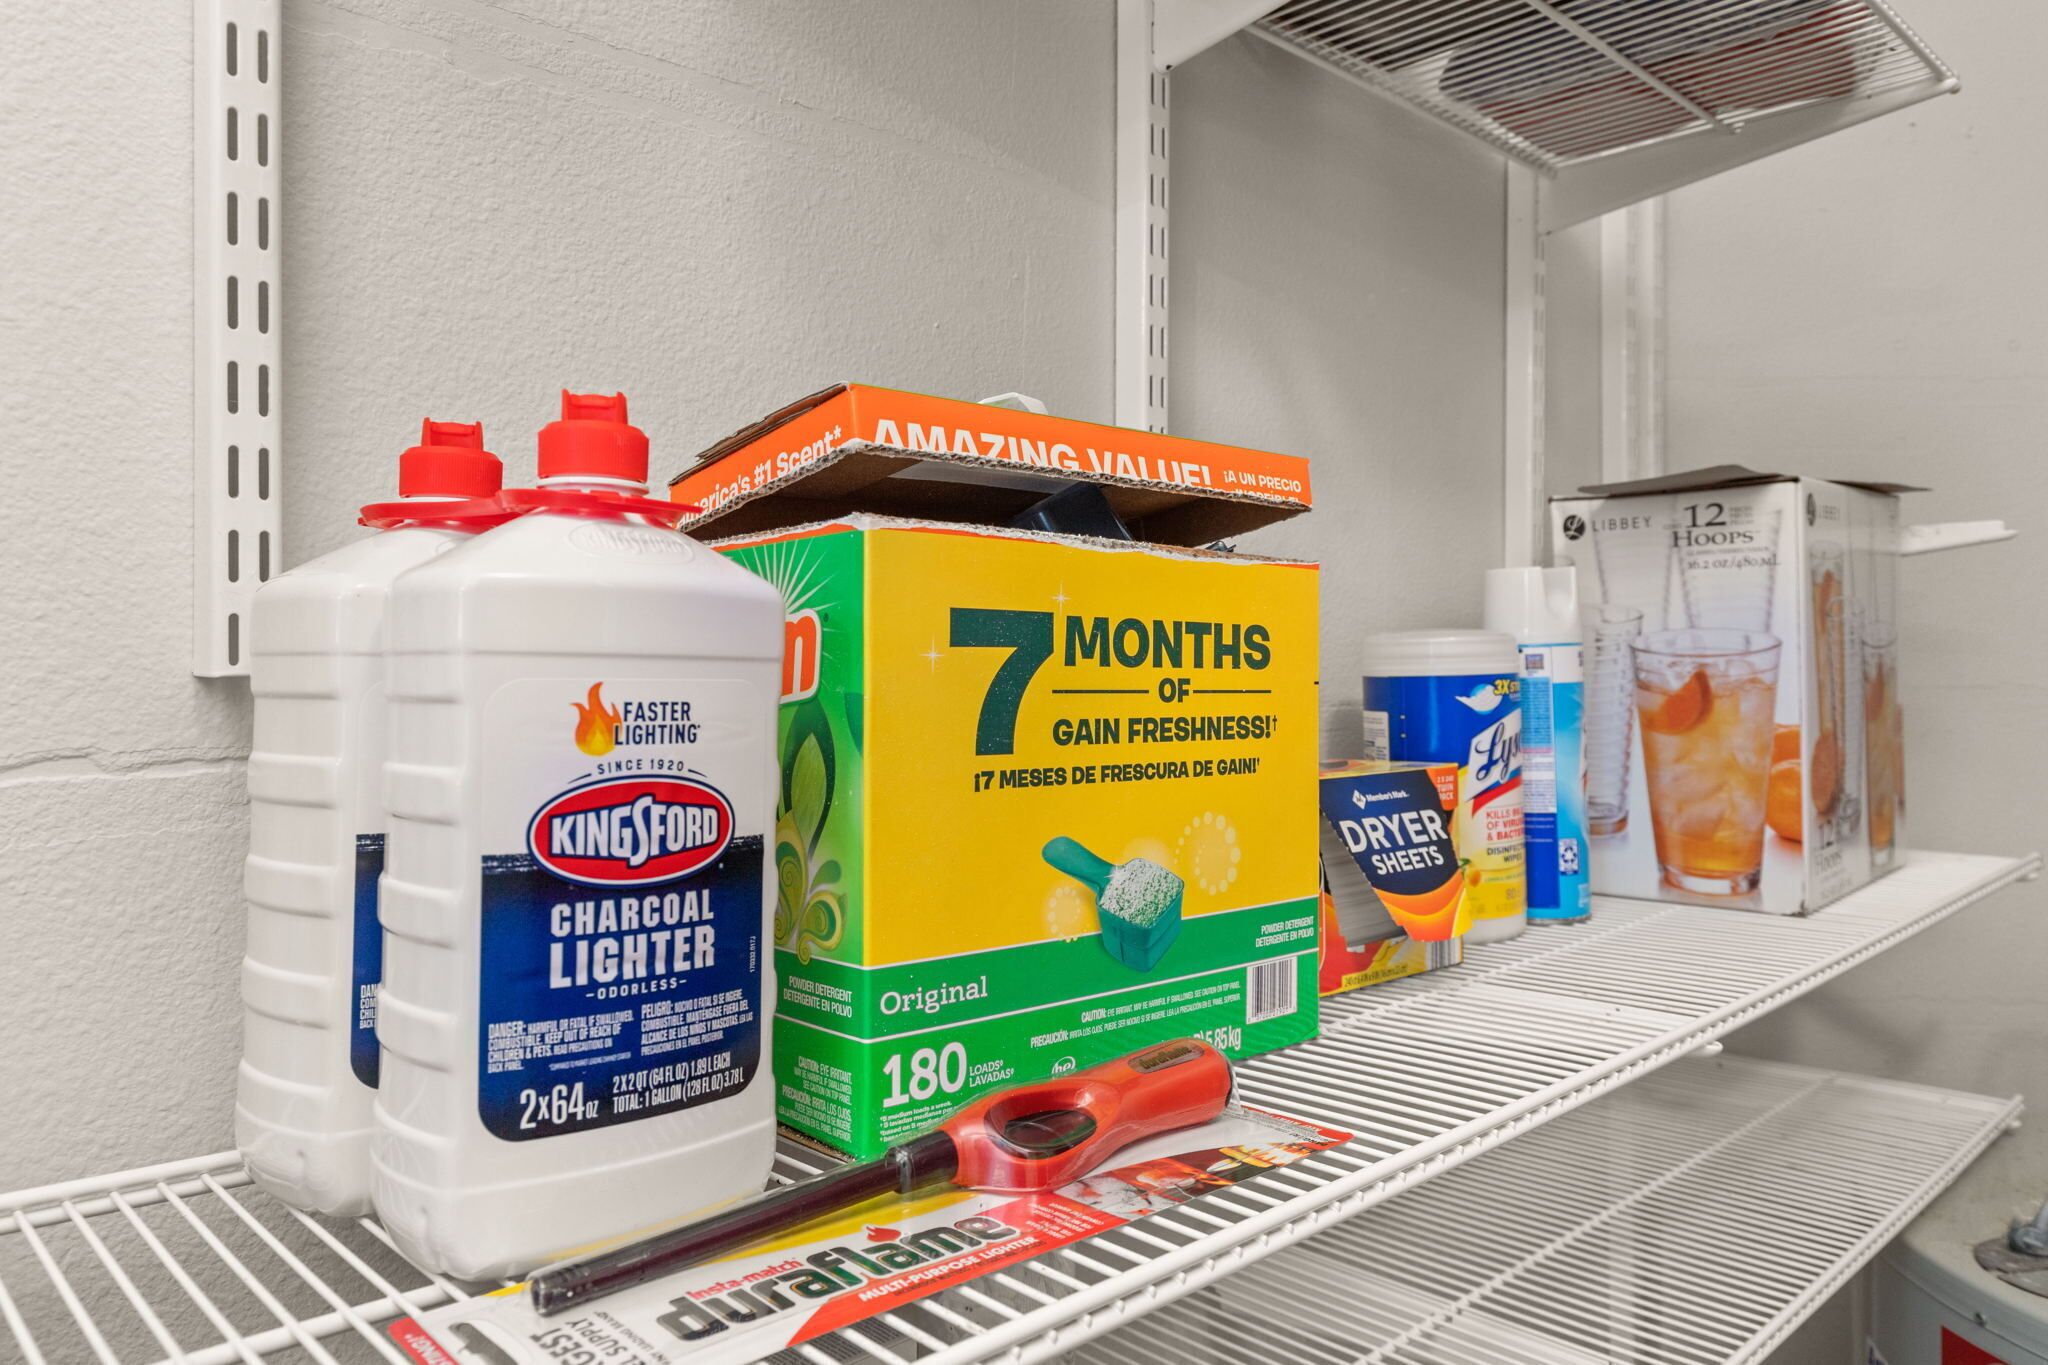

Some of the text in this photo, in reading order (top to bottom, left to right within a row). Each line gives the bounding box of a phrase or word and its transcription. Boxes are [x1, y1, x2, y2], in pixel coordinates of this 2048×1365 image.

[874, 419, 1080, 471] AMAZING
[754, 459, 773, 487] #1
[1239, 473, 1256, 487] UN
[1258, 475, 1302, 494] PRECIO
[1592, 515, 1653, 533] LIBBEY
[1684, 503, 1727, 529] 12
[950, 607, 1272, 755] 7 MONTHS
[1157, 678, 1192, 703] OF
[1493, 679, 1511, 697] 3X
[623, 702, 691, 722] FASTER
[1052, 718, 1121, 746] GAIN
[597, 759, 685, 775] SINCE 1920
[999, 767, 1067, 790] MESES
[1071, 764, 1096, 785] DE
[1100, 761, 1190, 783] FRESCURA
[1193, 760, 1214, 779] DE
[1487, 807, 1511, 820] KILLS
[1487, 821, 1501, 831] OF
[551, 794, 719, 868] KINGSFORD
[1339, 809, 1449, 853] DRYER
[1371, 844, 1445, 876] SHEETS
[550, 888, 714, 938] CHARCOAL
[1261, 916, 1314, 935] POWDER DETERGENT
[1256, 932, 1290, 948] DETERGENTE
[549, 924, 715, 989] LIGHTER
[789, 975, 853, 1003] POWDER DETERGENT
[879, 976, 989, 1016] Original
[641, 1000, 675, 1020] PELIGRO:
[783, 988, 853, 1019] DETERGENTE EN POLVO
[1081, 1007, 1107, 1023] CAUTION:
[488, 1020, 527, 1039] DANGER:
[544, 1031, 563, 1045] KEEP
[563, 1029, 578, 1043] OUT
[578, 1027, 589, 1041] OF
[589, 1026, 612, 1039] REACH
[612, 1022, 622, 1036] OF
[1228, 1025, 1242, 1051] kg
[532, 1044, 553, 1059] PETS.
[649, 1068, 666, 1092] (64
[665, 1066, 675, 1083] FL
[675, 1063, 690, 1083] OZ)
[691, 1059, 707, 1077] 1.89
[713, 1052, 731, 1071] EACH
[881, 1040, 968, 1109] 180
[612, 1094, 643, 1114] TOTAL:
[651, 1084, 682, 1106] GALLON
[724, 1068, 740, 1088] 3.78
[655, 1215, 1022, 1342] duraflame
[857, 1255, 981, 1303] MULTI-PURPOSE
[980, 1236, 1040, 1260] LIGHTER
[564, 1317, 629, 1358] SUPPLY
